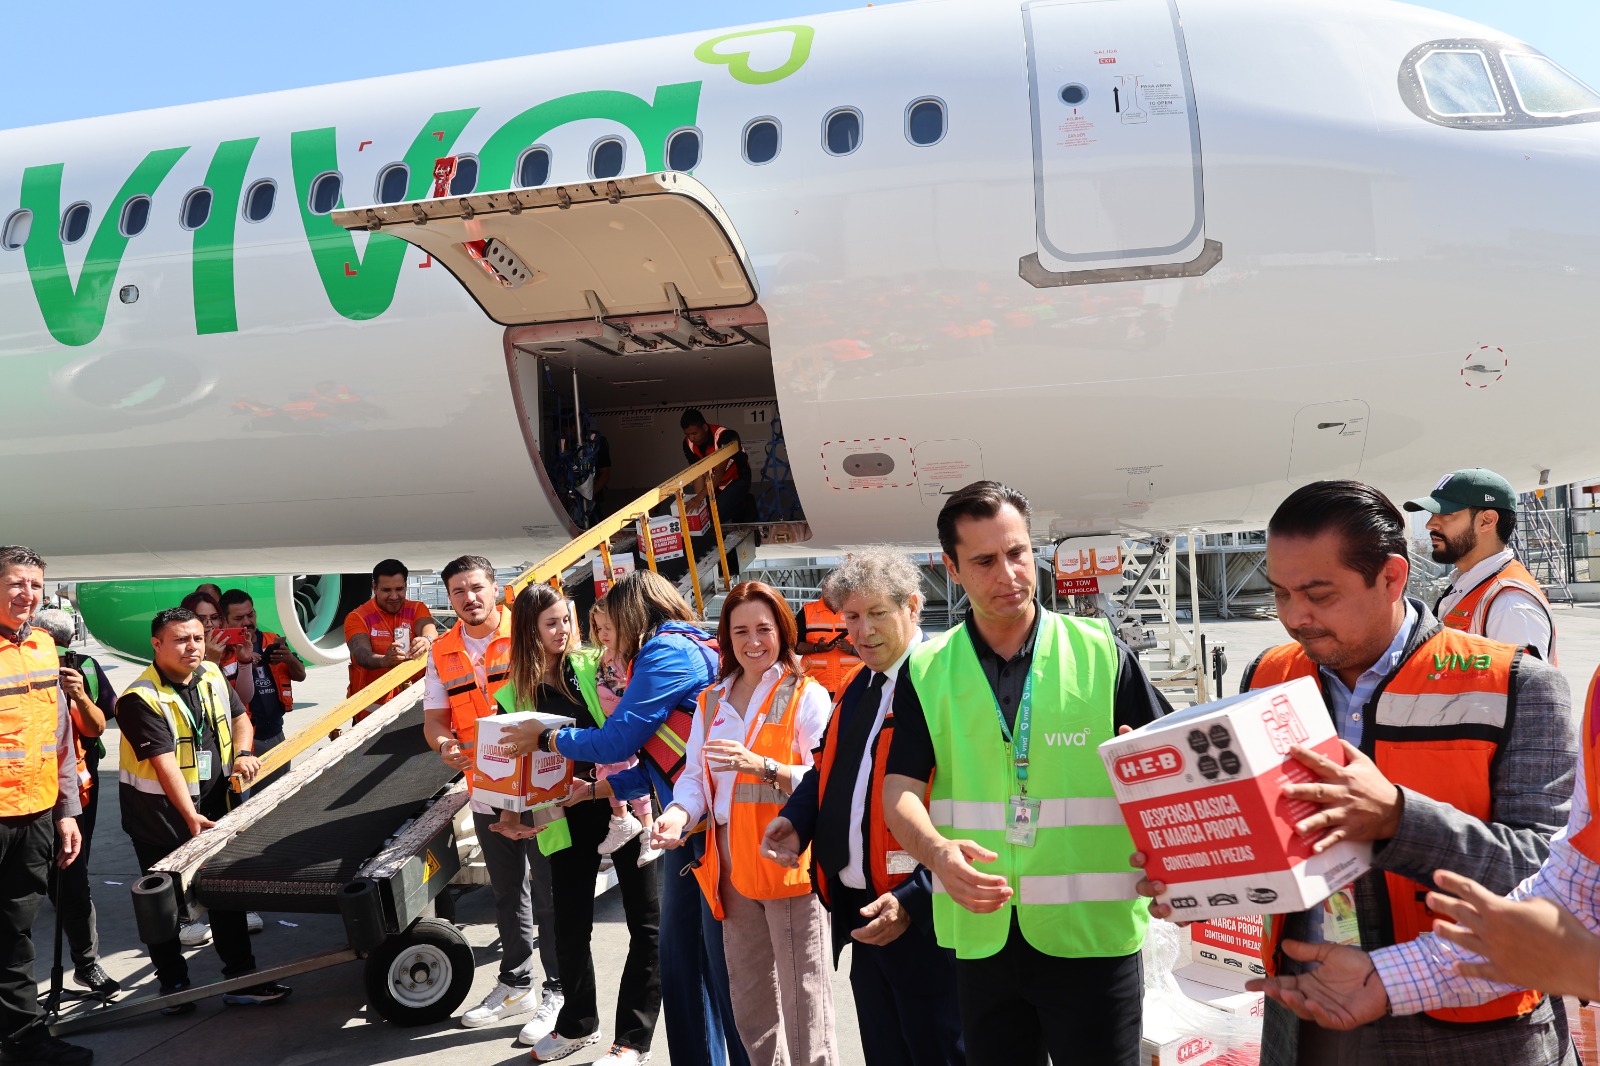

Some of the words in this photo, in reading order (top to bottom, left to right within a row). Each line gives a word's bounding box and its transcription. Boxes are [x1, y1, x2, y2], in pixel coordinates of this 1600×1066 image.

[751, 410, 765, 422] 11
[1139, 802, 1197, 828] DESPENSA
[1193, 794, 1241, 819] BASICA
[1147, 830, 1165, 849] DE
[1161, 824, 1207, 847] MARCA
[1202, 816, 1252, 841] PROPIA
[1162, 851, 1211, 871] CONTENIDO
[1209, 850, 1221, 865] 11
[1219, 845, 1255, 864] PIEZAS
[1211, 918, 1237, 931] MARCA
[1204, 929, 1235, 944] CONTENIDO
[1235, 937, 1242, 946] 11
[1242, 938, 1262, 952] PIEZAS
